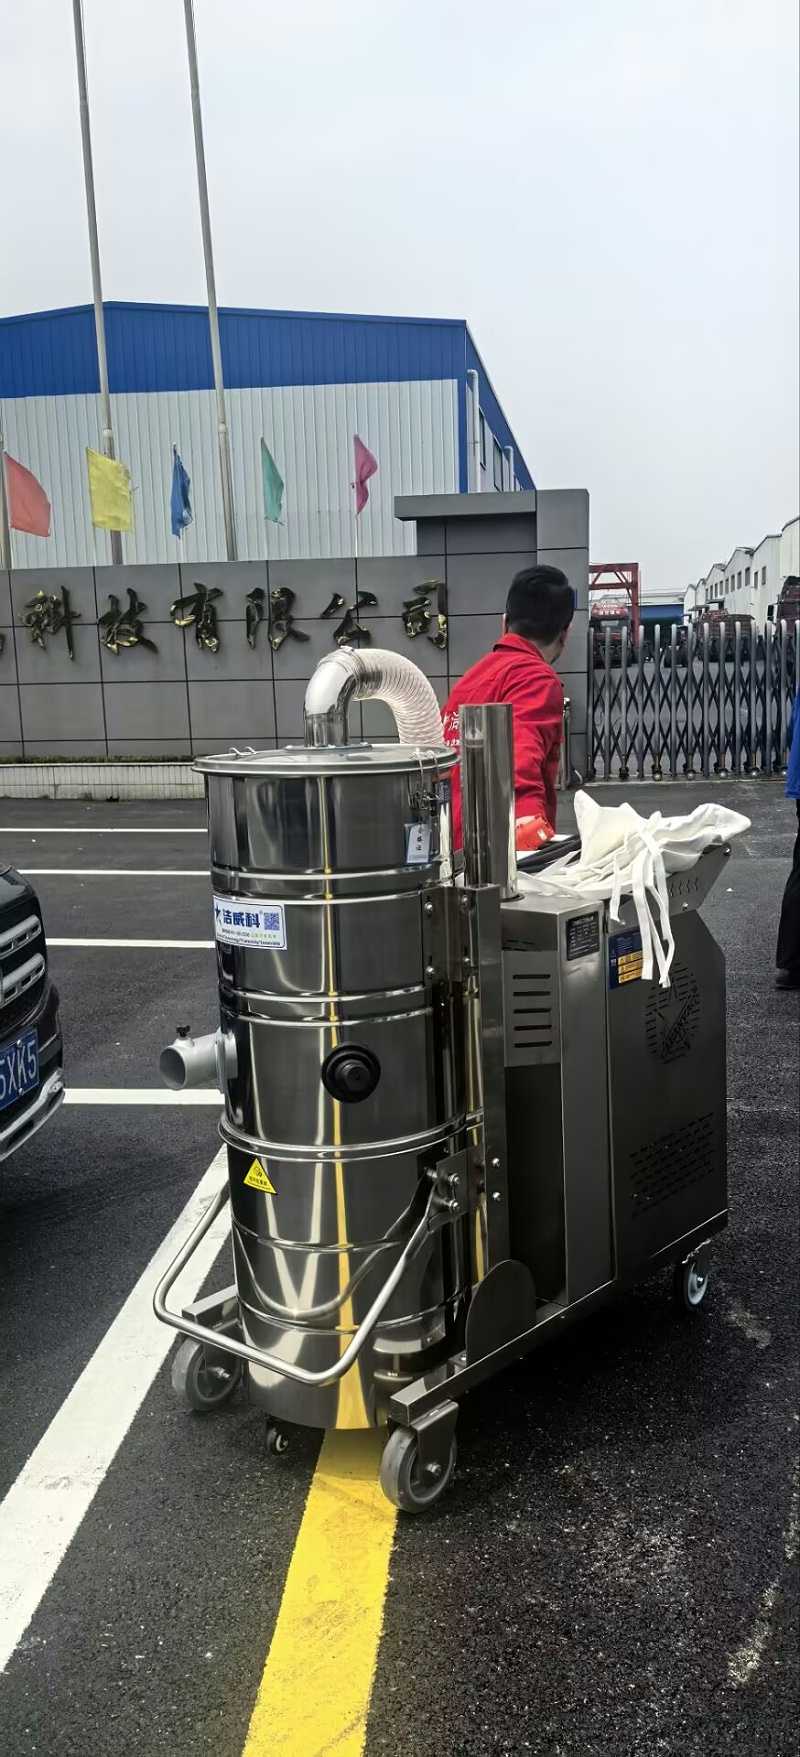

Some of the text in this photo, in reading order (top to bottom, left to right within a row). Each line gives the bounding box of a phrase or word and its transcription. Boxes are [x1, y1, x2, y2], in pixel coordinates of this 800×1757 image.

[0, 580, 449, 661] 科技有限公司
[222, 908, 261, 928] 洁威科
